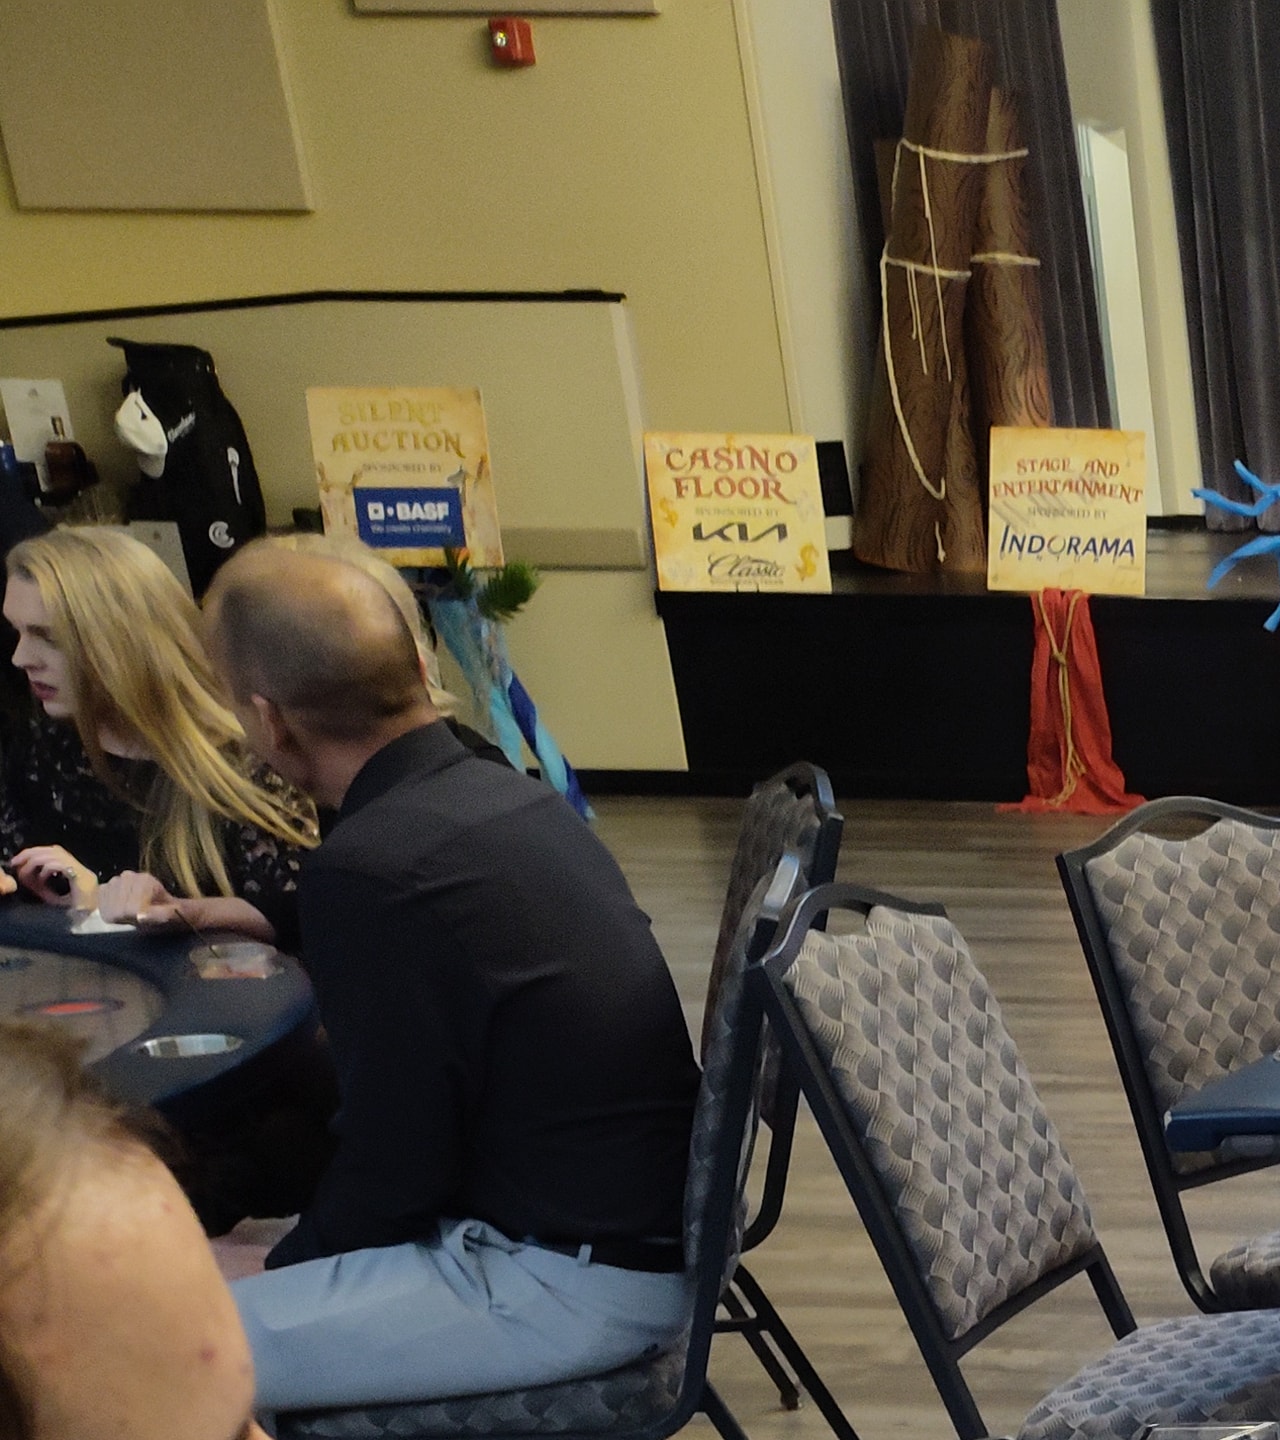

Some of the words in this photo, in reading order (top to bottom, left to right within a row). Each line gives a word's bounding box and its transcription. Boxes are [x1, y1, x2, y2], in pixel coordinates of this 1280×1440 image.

[338, 398, 443, 427] SILENT
[332, 428, 465, 459] AUCTION
[665, 445, 798, 476] CASINO
[1016, 458, 1072, 475] STAGE
[1084, 458, 1120, 479] AND
[673, 474, 797, 505] FLOOR
[992, 476, 1144, 505] ENTERTAINMENT
[396, 501, 450, 521] BASF
[692, 521, 788, 543] KIA
[999, 524, 1135, 558] INDORAMA
[708, 554, 785, 577] Classic
